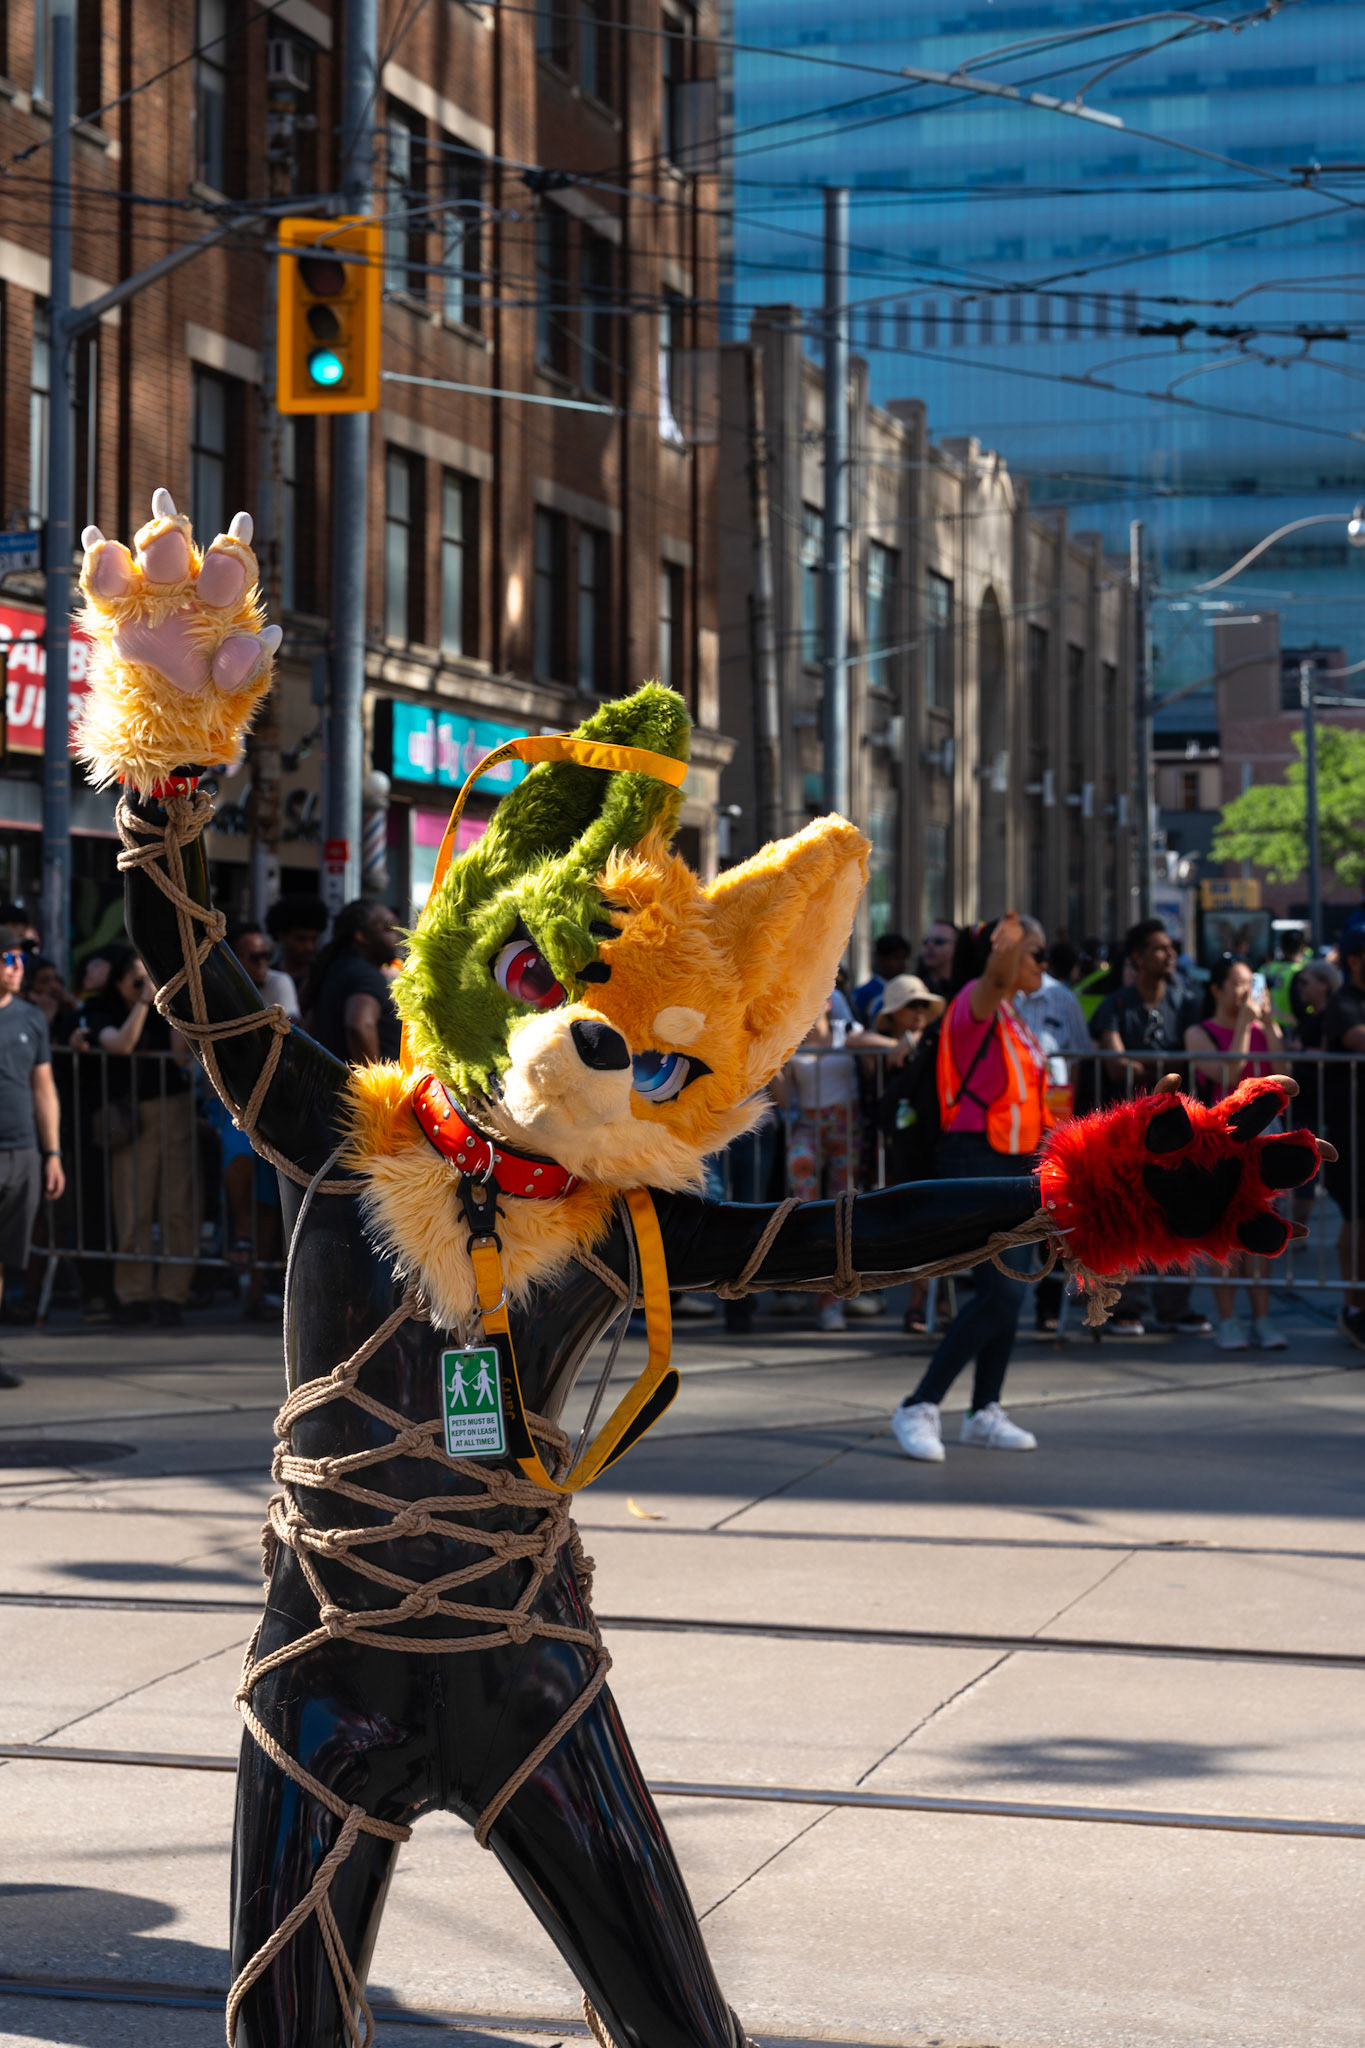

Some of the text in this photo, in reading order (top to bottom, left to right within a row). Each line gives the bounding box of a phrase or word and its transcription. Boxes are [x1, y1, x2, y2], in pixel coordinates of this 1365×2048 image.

[452, 1416, 495, 1427] PETS MUST BE
[451, 1427, 497, 1437] KEPT ON LEASH
[456, 1439, 463, 1447] AT
[476, 1437, 496, 1446] TIMES
